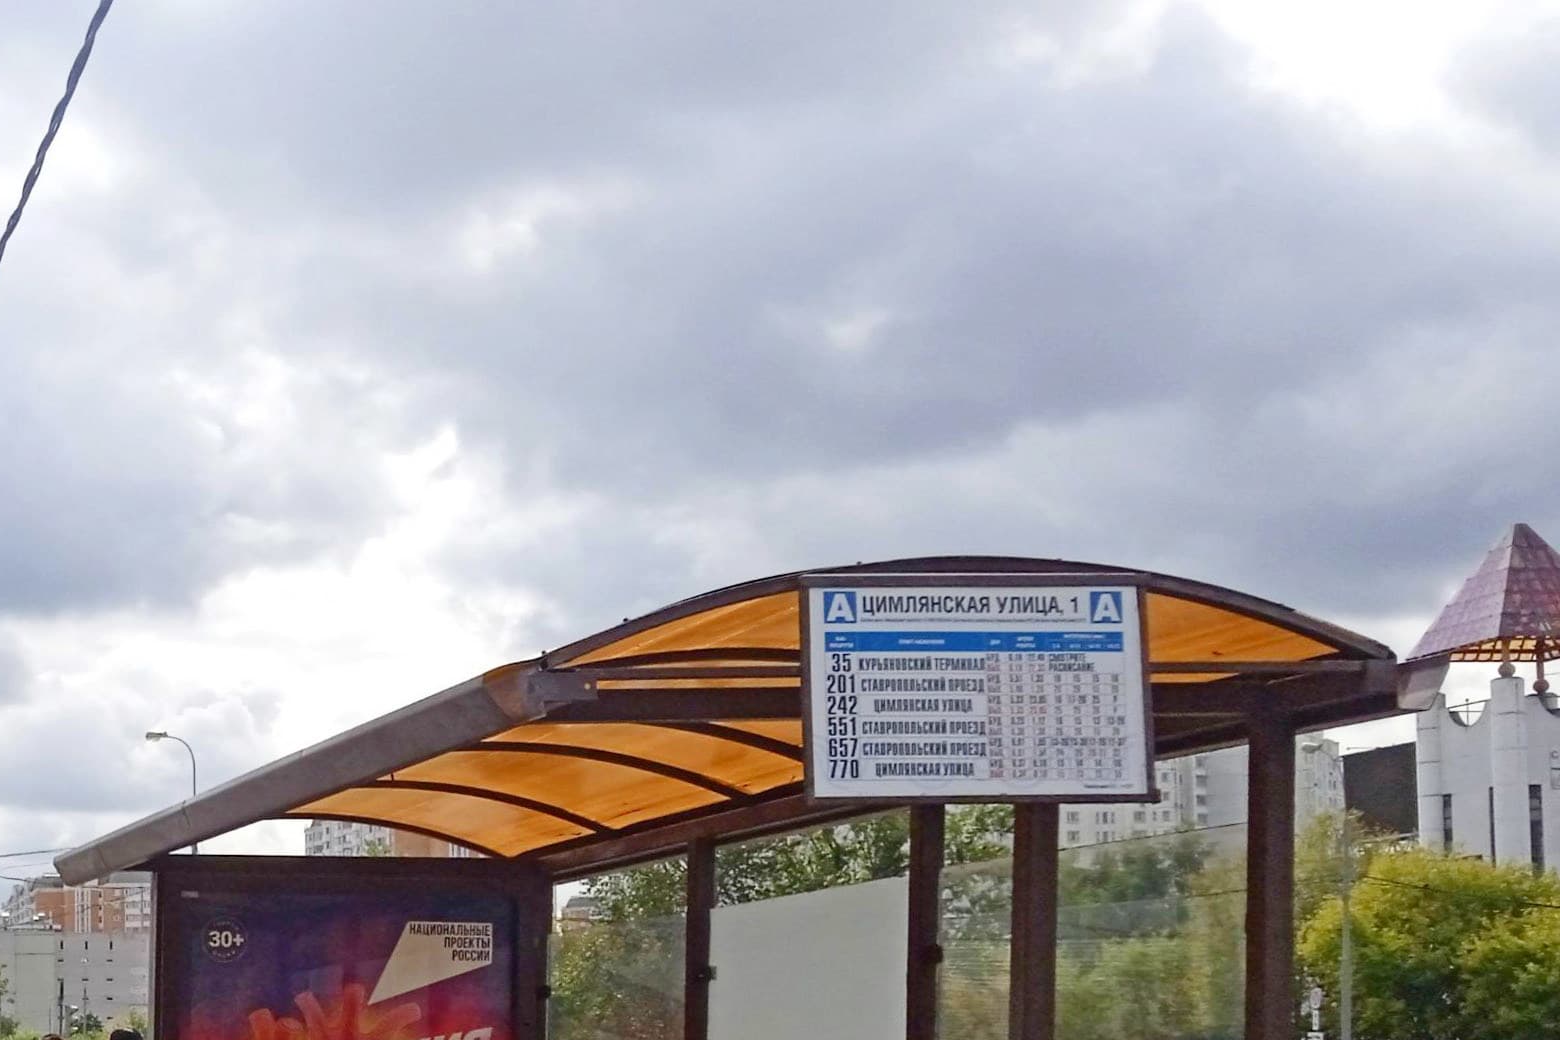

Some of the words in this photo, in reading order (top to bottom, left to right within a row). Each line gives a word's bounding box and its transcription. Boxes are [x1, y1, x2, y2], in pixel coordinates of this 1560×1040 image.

[862, 596, 990, 616] ЦИМЛЯНСКАЯ
[996, 597, 1064, 615] УЛИЦА,
[1070, 597, 1079, 613] 1
[832, 653, 851, 672] 35
[859, 656, 933, 671] КУРЬЯНОВСКИЙ
[935, 658, 985, 671] ТЕРМИНАЛ
[827, 674, 855, 693] 201
[861, 677, 946, 692] СТАВРОПОЛЬСКИЙ
[948, 678, 985, 693] ПРОЕЗД
[827, 696, 857, 715] 242
[874, 699, 939, 713] ЦИМЛЯНСКАЯ
[942, 699, 973, 713] УЛИЦА
[828, 717, 856, 736] 551
[862, 720, 947, 735] СТАВРОПОЛЬСКИЙ
[949, 721, 986, 735] ПРОЕЗД
[829, 738, 858, 757] 657
[862, 741, 948, 756] СТАВРОПОЛЬСКИЙ
[950, 743, 987, 757] ПРОЕЗД
[830, 760, 859, 778] 770
[875, 763, 940, 777] ЦИМЛЯНСКАЯ
[943, 763, 974, 777] УЛИЦА
[208, 930, 244, 948] 30+
[409, 922, 491, 937] НАЦИОНАЛЬНЫЕ
[443, 936, 491, 949] ПРОЕКТЫ
[451, 949, 491, 962] РОССИИ
